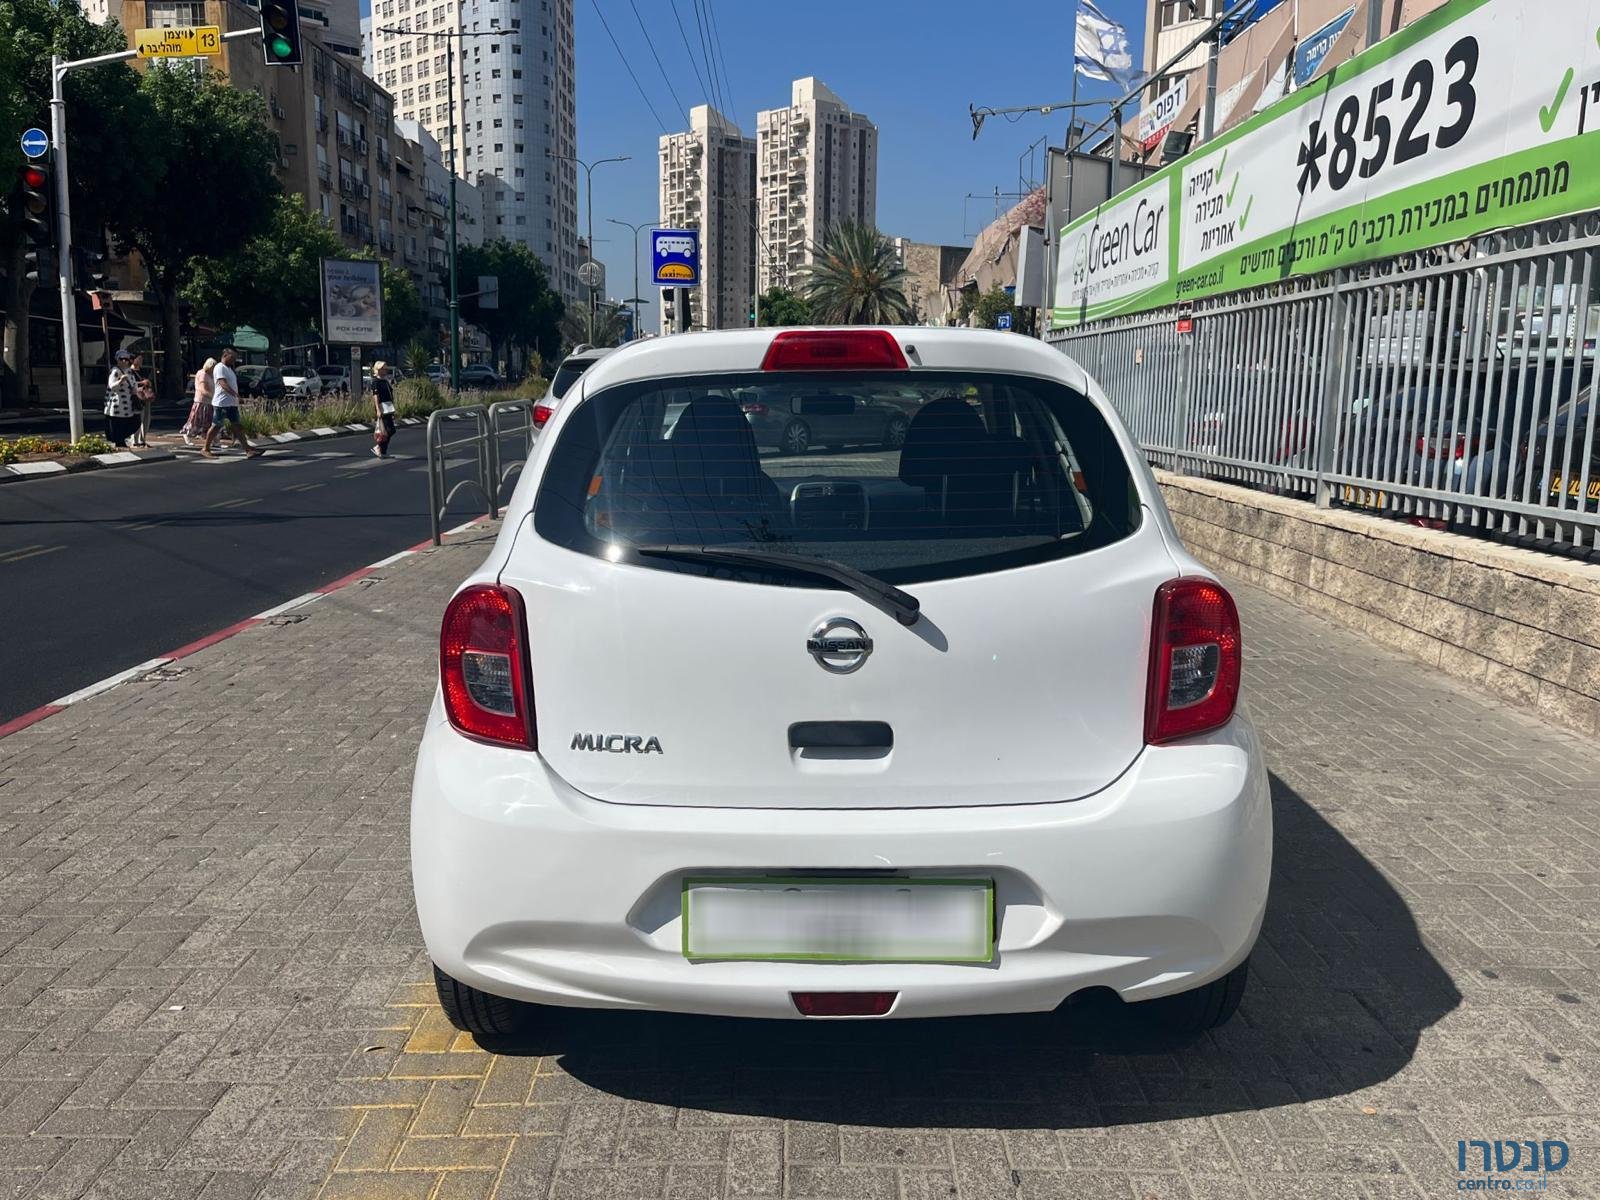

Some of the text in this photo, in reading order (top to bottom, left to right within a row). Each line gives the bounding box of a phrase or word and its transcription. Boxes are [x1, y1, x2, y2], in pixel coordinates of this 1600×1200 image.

[146, 41, 182, 53] מוהליבר
[164, 30, 187, 42] ויצמן
[201, 33, 215, 47] 13
[1156, 87, 1181, 121] דפוס
[1189, 168, 1214, 197] קנייה
[1474, 160, 1570, 214] מתמחים
[1195, 193, 1224, 224] מכירה
[1398, 191, 1469, 238] במכירת
[1088, 198, 1164, 274] Green Car
[1200, 220, 1236, 252] אחריות
[1348, 219, 1358, 249] 0
[1361, 213, 1395, 245] רכבי
[1240, 247, 1275, 276] חדשים
[1278, 236, 1316, 266] ורכבים
[1176, 264, 1224, 298] green-car.co.il
[814, 640, 866, 650] NISSAN
[570, 732, 664, 755] MICRA
